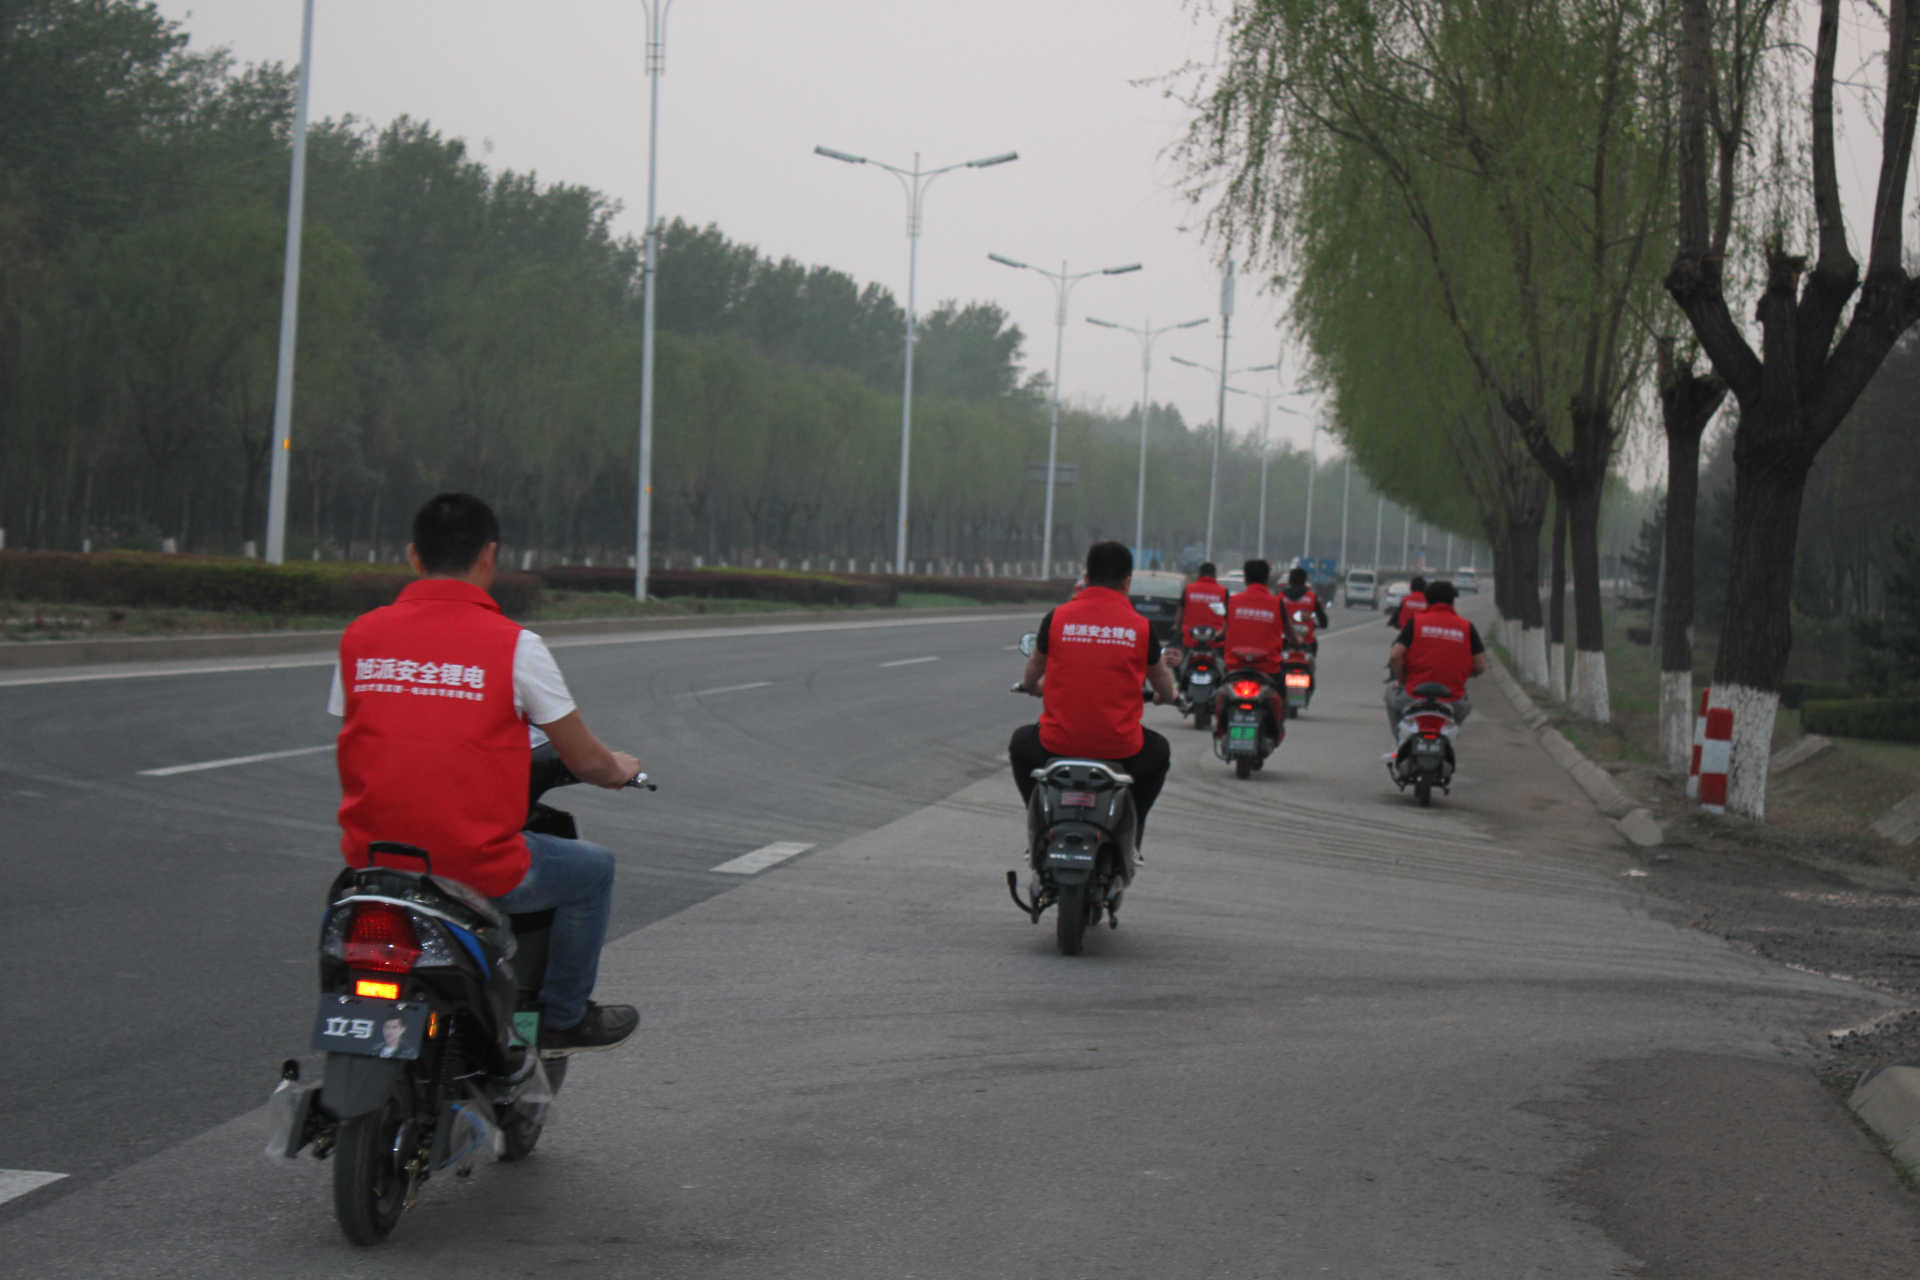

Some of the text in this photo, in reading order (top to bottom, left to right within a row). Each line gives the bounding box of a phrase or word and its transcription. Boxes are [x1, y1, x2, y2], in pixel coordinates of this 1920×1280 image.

[355, 658, 485, 688] 旭派安全锂电
[323, 1016, 375, 1039] 立马
